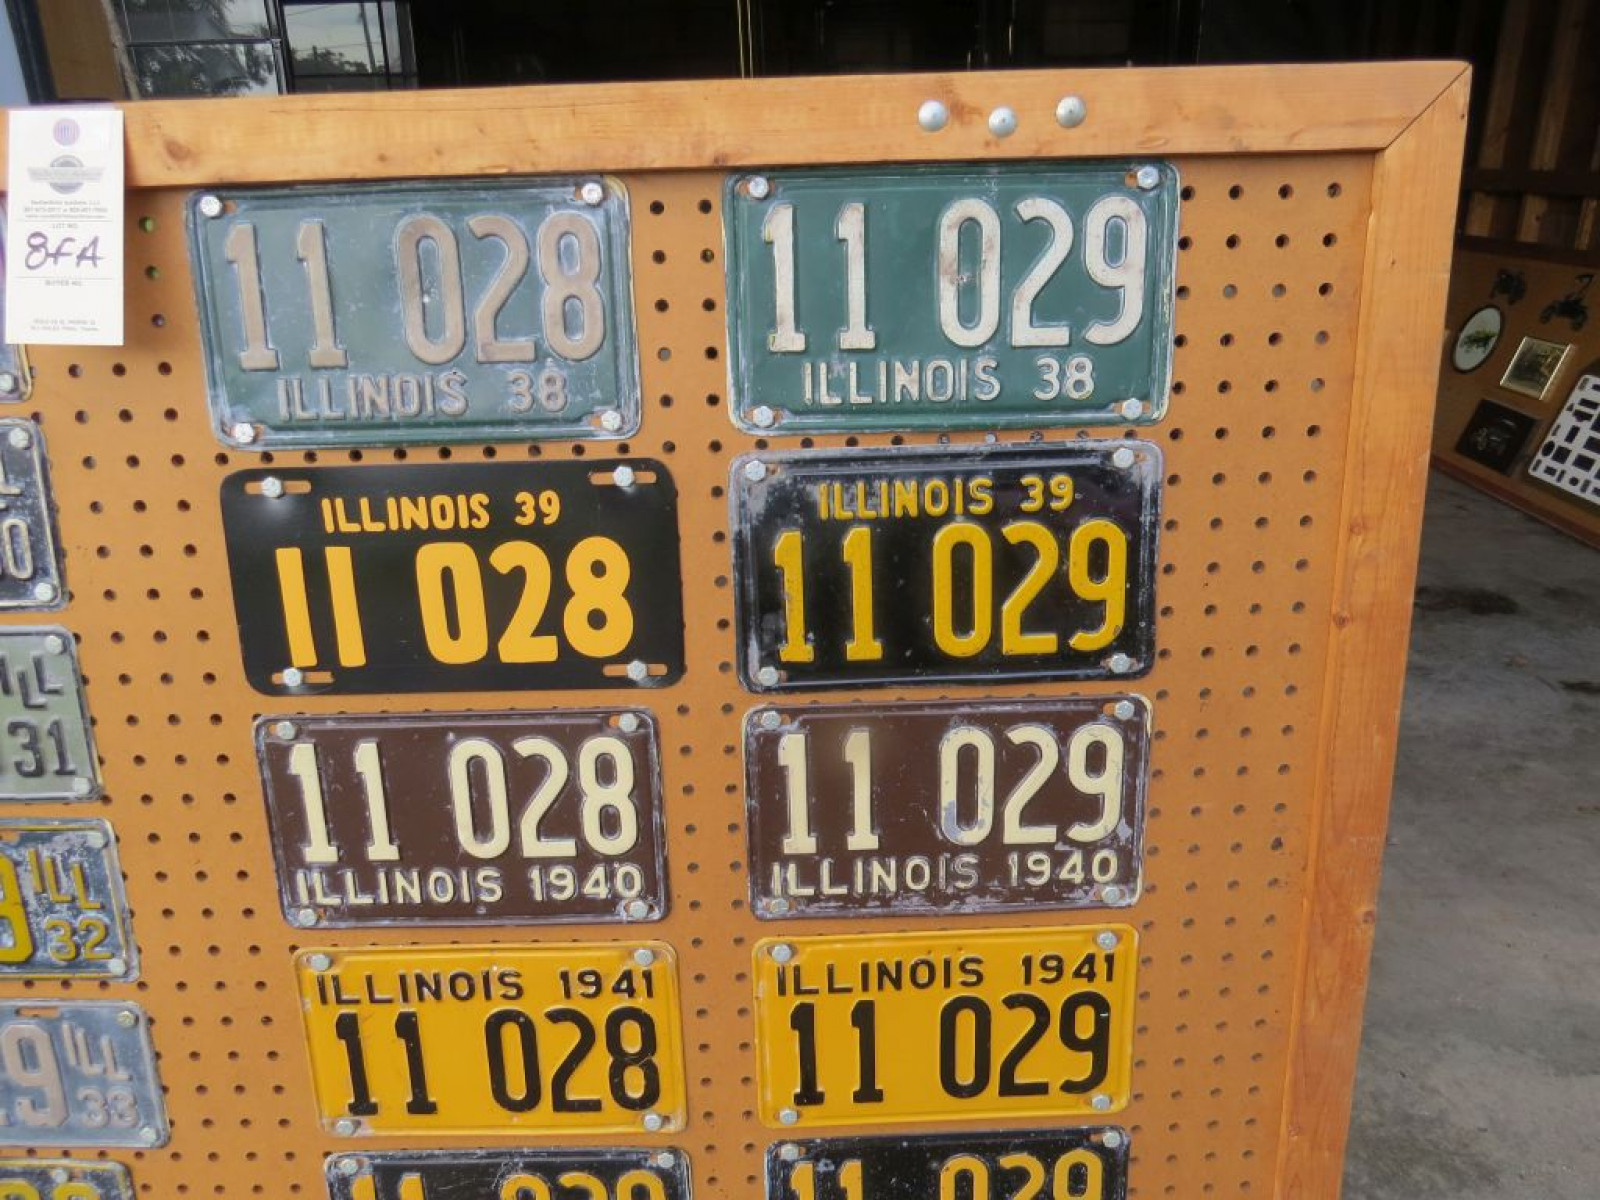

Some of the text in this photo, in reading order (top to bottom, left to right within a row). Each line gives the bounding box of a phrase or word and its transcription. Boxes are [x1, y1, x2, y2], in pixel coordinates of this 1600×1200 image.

[225, 212, 604, 370] 11 028
[764, 197, 1147, 352] 11 029
[277, 370, 568, 420] ILLINOIS 38
[803, 357, 1094, 404] ILLINOIS 38
[322, 490, 560, 533] ILLINOIS 39
[818, 475, 1075, 520] ILLINOIS 39
[415, 536, 633, 664] 028
[774, 519, 1127, 661] 11 029
[8, 720, 76, 777] 31
[289, 737, 637, 862] 11 028
[778, 724, 1124, 854] 11 029
[27, 848, 102, 909] ILL
[297, 863, 643, 904] ILLINOIS 1940
[772, 850, 1118, 896] ILLINOIS 1940
[46, 917, 114, 961] 32
[316, 969, 654, 1004] ILLINOIS 1941
[776, 952, 1115, 996] ILLINOIS 1941
[62, 1022, 132, 1081] ILL
[336, 1006, 660, 1115] 11 028
[790, 991, 1110, 1105] 11 029
